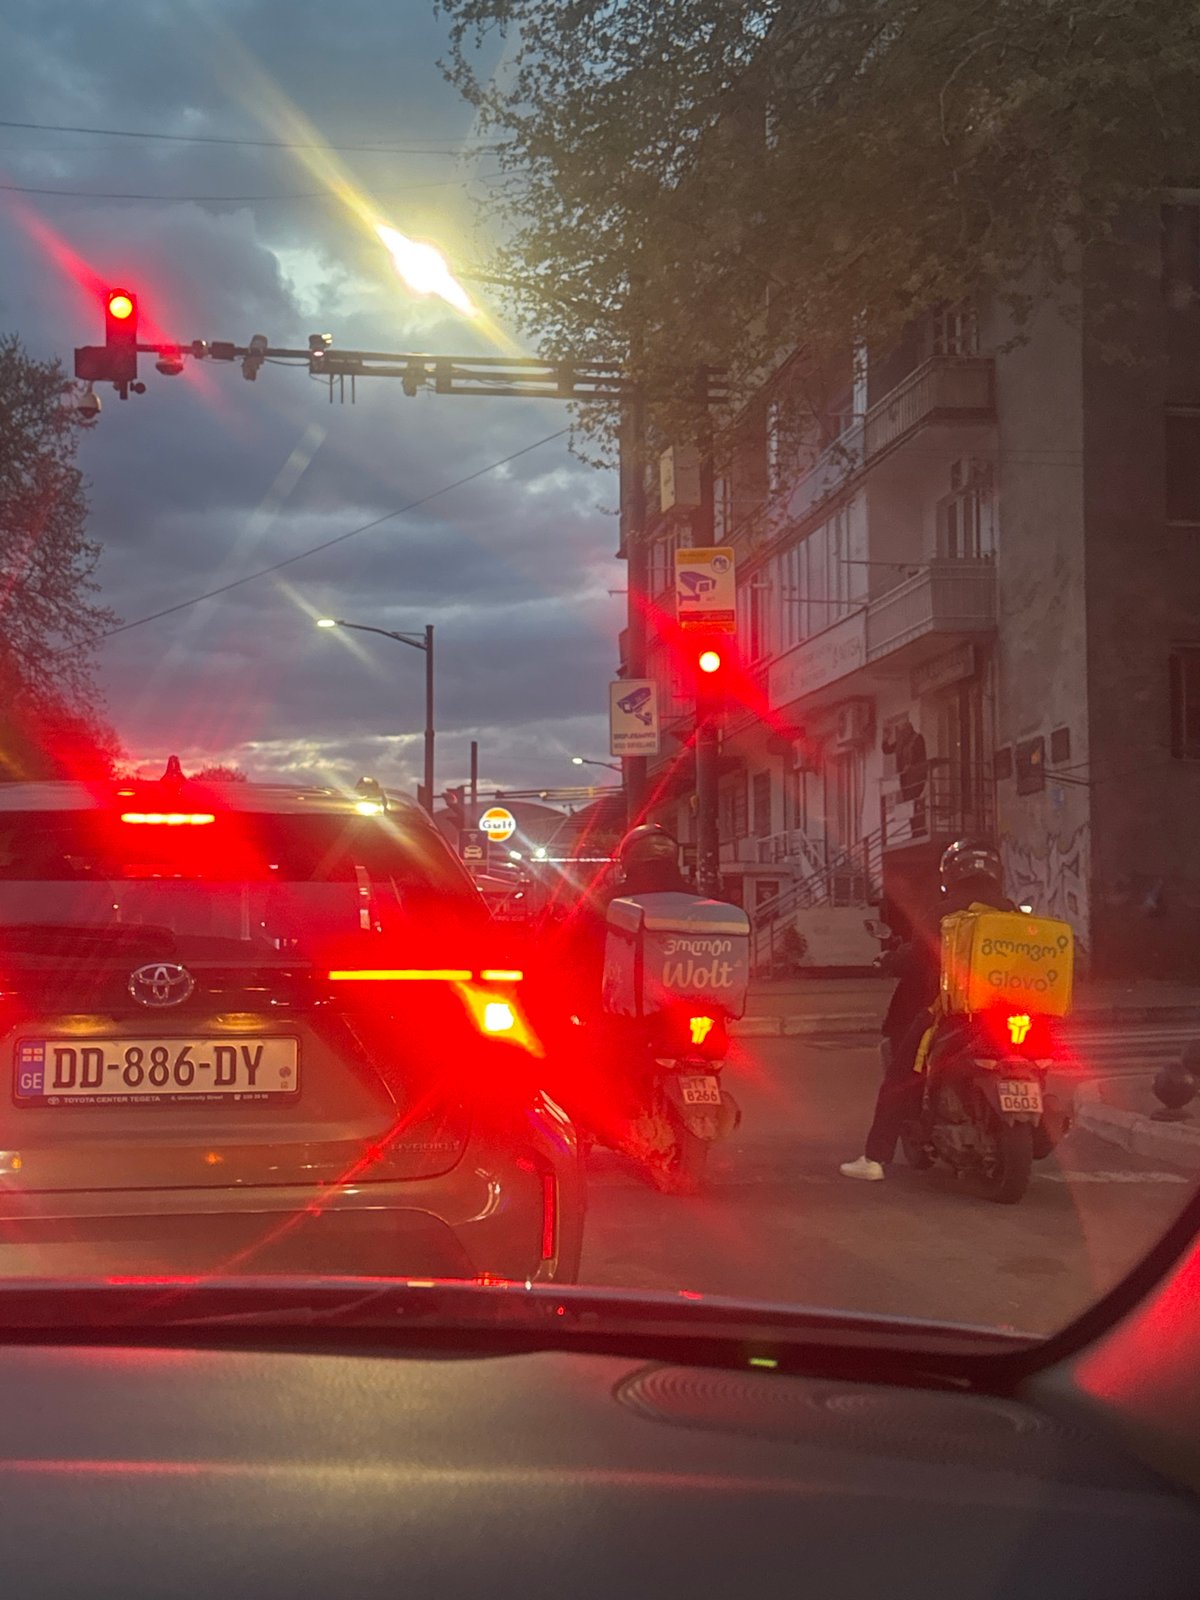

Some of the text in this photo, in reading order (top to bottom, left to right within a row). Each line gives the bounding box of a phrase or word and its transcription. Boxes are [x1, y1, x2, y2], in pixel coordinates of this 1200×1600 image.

[482, 819, 512, 829] Gulf
[981, 938, 1057, 962] გლოვო
[663, 959, 734, 989] Wolt
[988, 970, 1047, 993] Glovo
[52, 1045, 264, 1088] DD-886-DY
[21, 1073, 42, 1089] GE
[64, 1096, 95, 1104] TOYOTA
[130, 1095, 160, 1103] TEGETA
[687, 1090, 718, 1102] 8266
[1004, 1096, 1039, 1109] 0603
